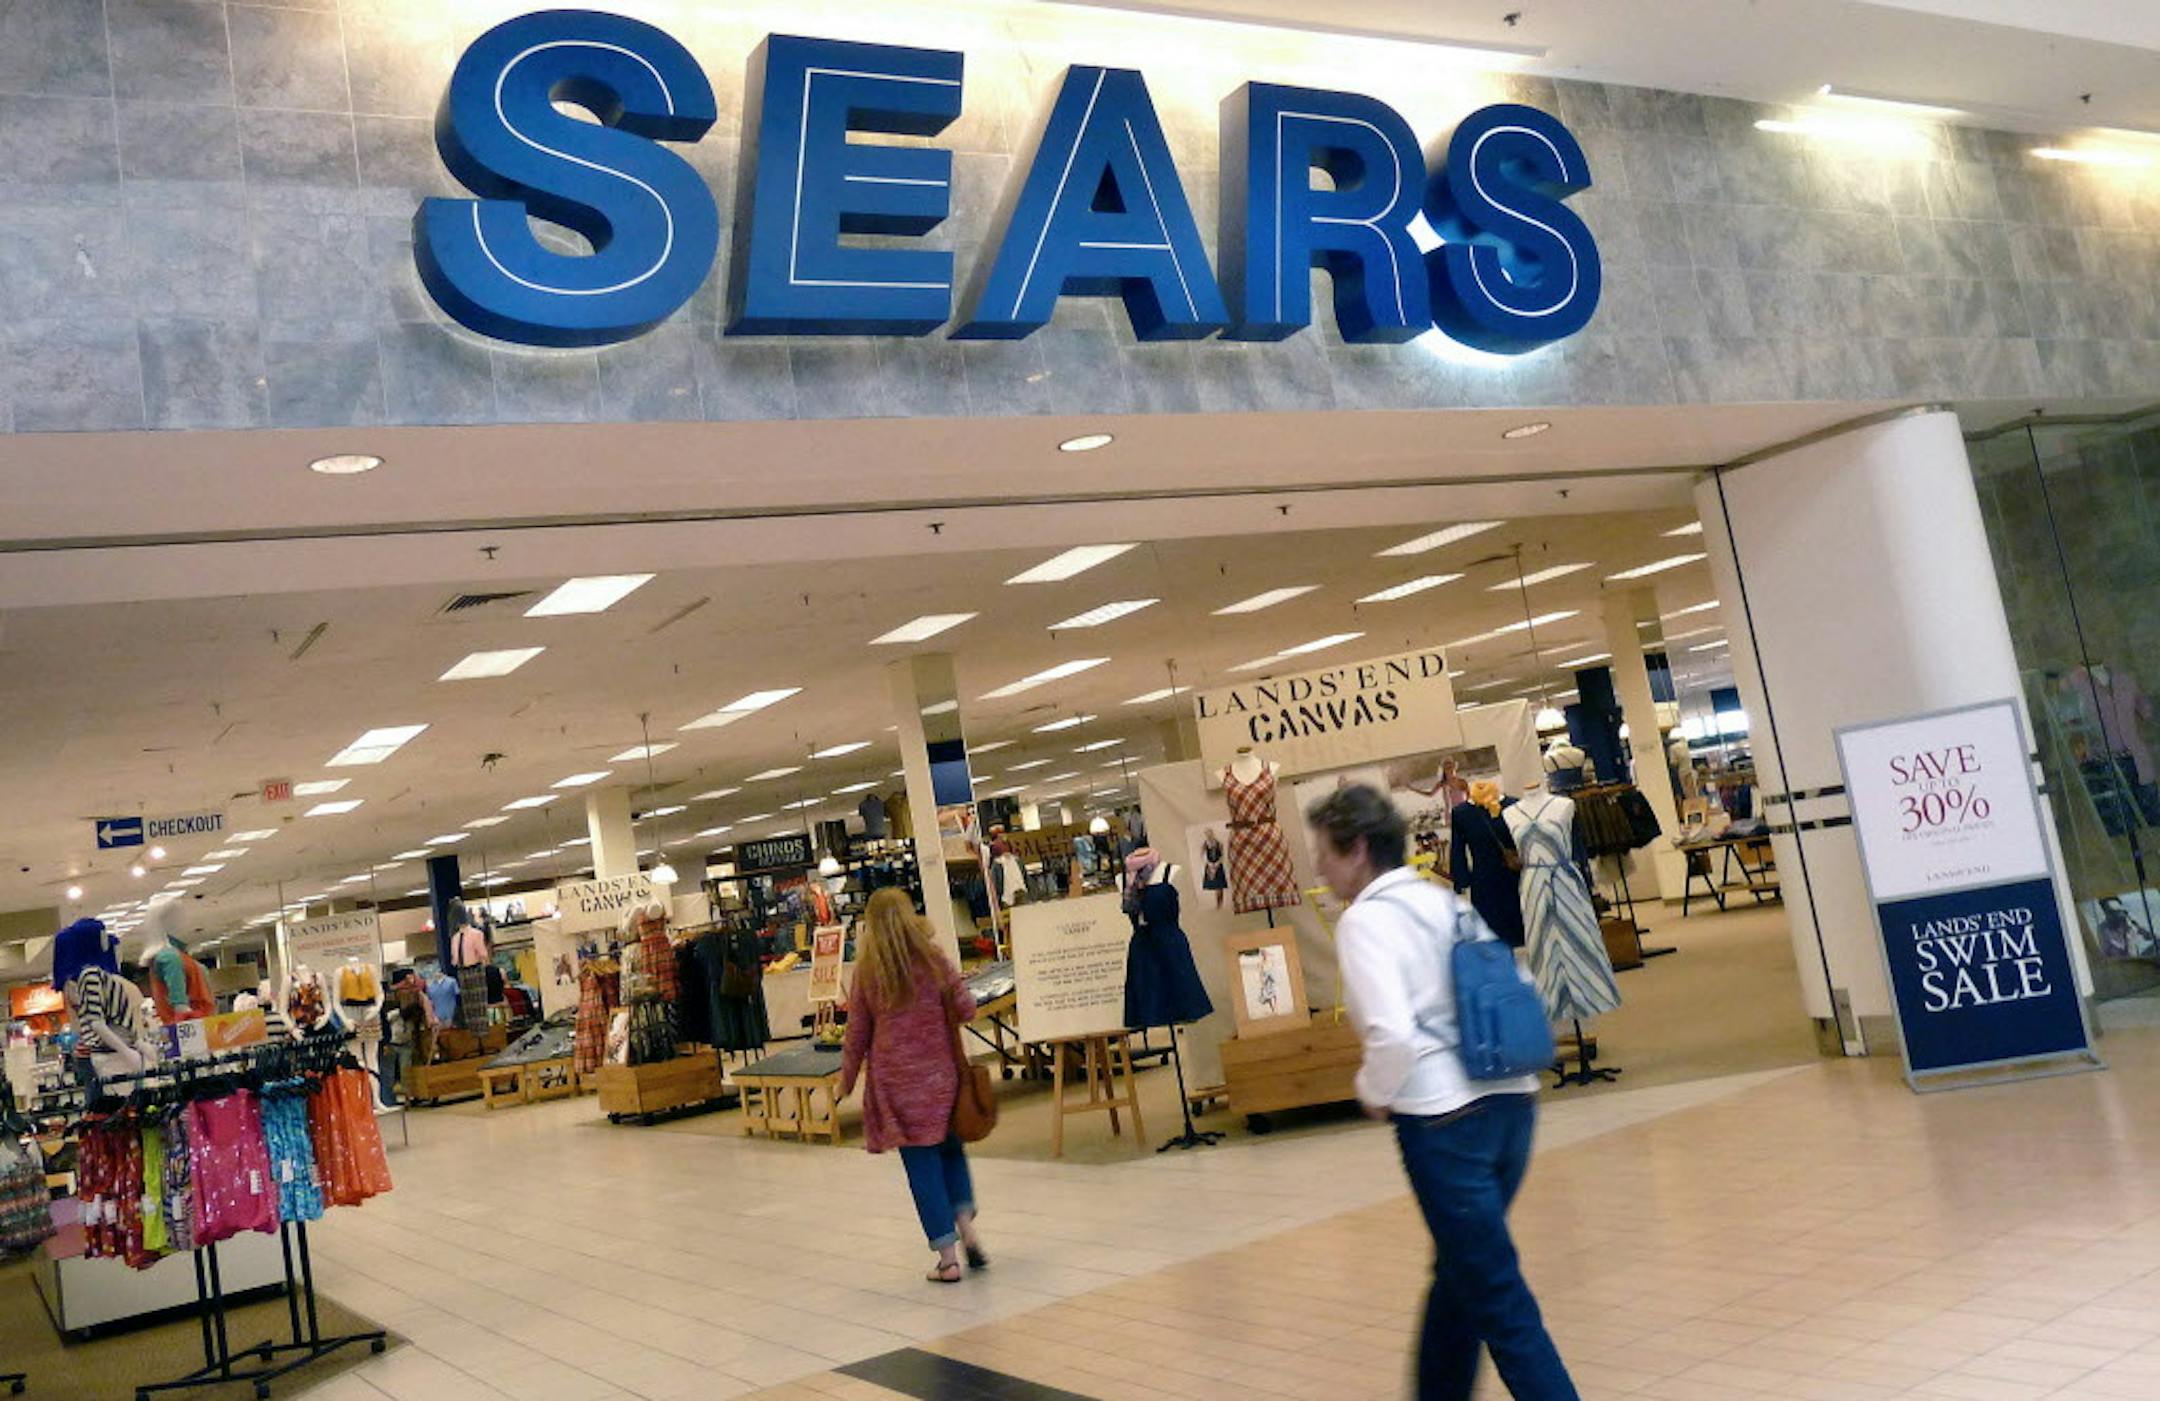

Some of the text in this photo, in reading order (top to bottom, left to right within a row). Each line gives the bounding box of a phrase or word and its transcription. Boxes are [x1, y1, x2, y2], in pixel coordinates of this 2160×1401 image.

[414, 8, 1602, 355] SEARS
[1249, 690, 1400, 743] CANVAS
[1889, 744, 1981, 786] SAVE
[264, 782, 290, 801] EXIT
[1900, 784, 1990, 833] 30%
[149, 814, 223, 838] CHECKOUT
[746, 839, 805, 859] CHINOS
[1911, 907, 2032, 941] LANDS' END
[1916, 924, 2040, 972] SWIM
[1922, 957, 2052, 1012] SALE
